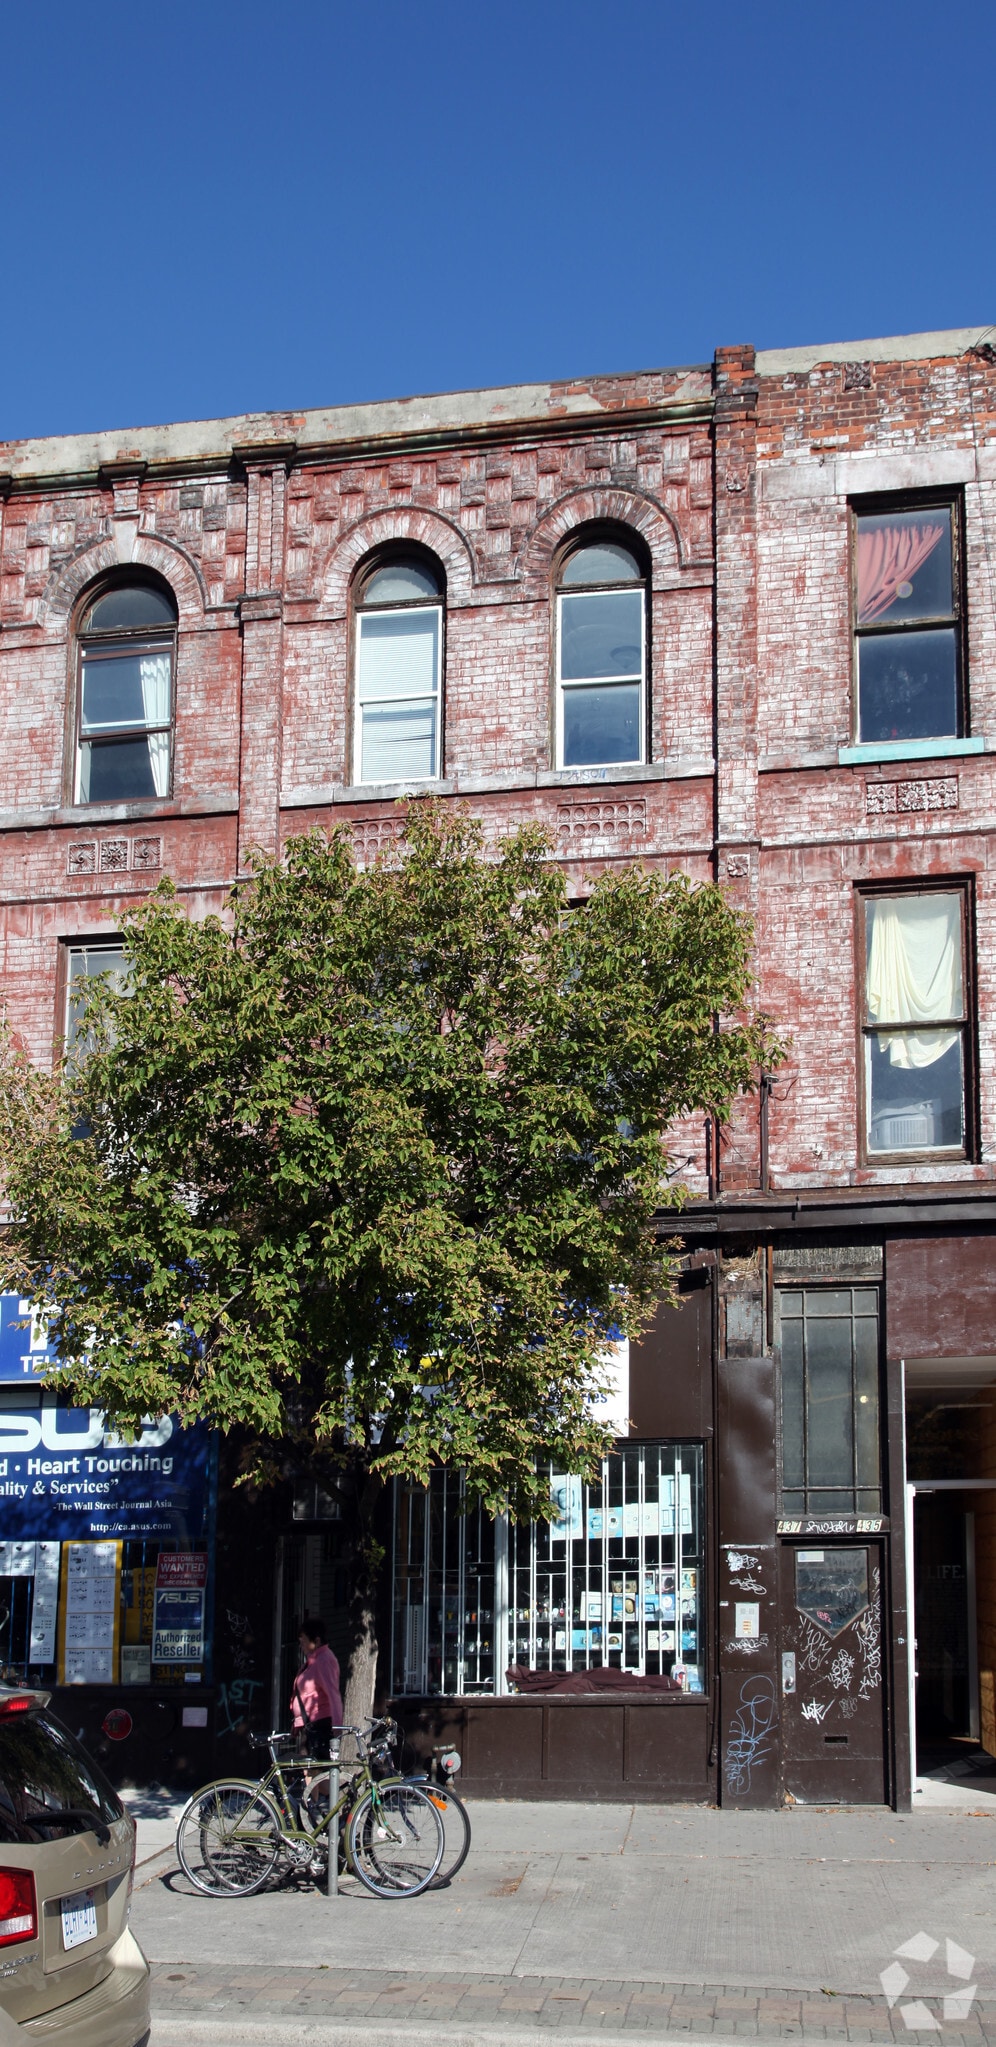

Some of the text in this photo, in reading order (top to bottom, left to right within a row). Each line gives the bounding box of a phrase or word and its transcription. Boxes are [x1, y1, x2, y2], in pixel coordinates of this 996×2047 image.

[27, 1456, 81, 1475] Heart
[85, 1454, 173, 1475] Touching
[32, 1480, 46, 1495] &
[74, 1501, 93, 1511] Wall
[95, 1501, 118, 1511] Street
[121, 1500, 152, 1510] Journal
[154, 1499, 172, 1508] Asia
[90, 1522, 171, 1533] http://ca.asus.com
[778, 1521, 801, 1533] 437
[857, 1519, 882, 1532] 435
[163, 1555, 204, 1563] CUSTOMERS
[160, 1563, 206, 1573] WANTED
[157, 1592, 201, 1604] ASUS
[155, 1631, 202, 1643] Authorized
[154, 1643, 201, 1657] Reseller
